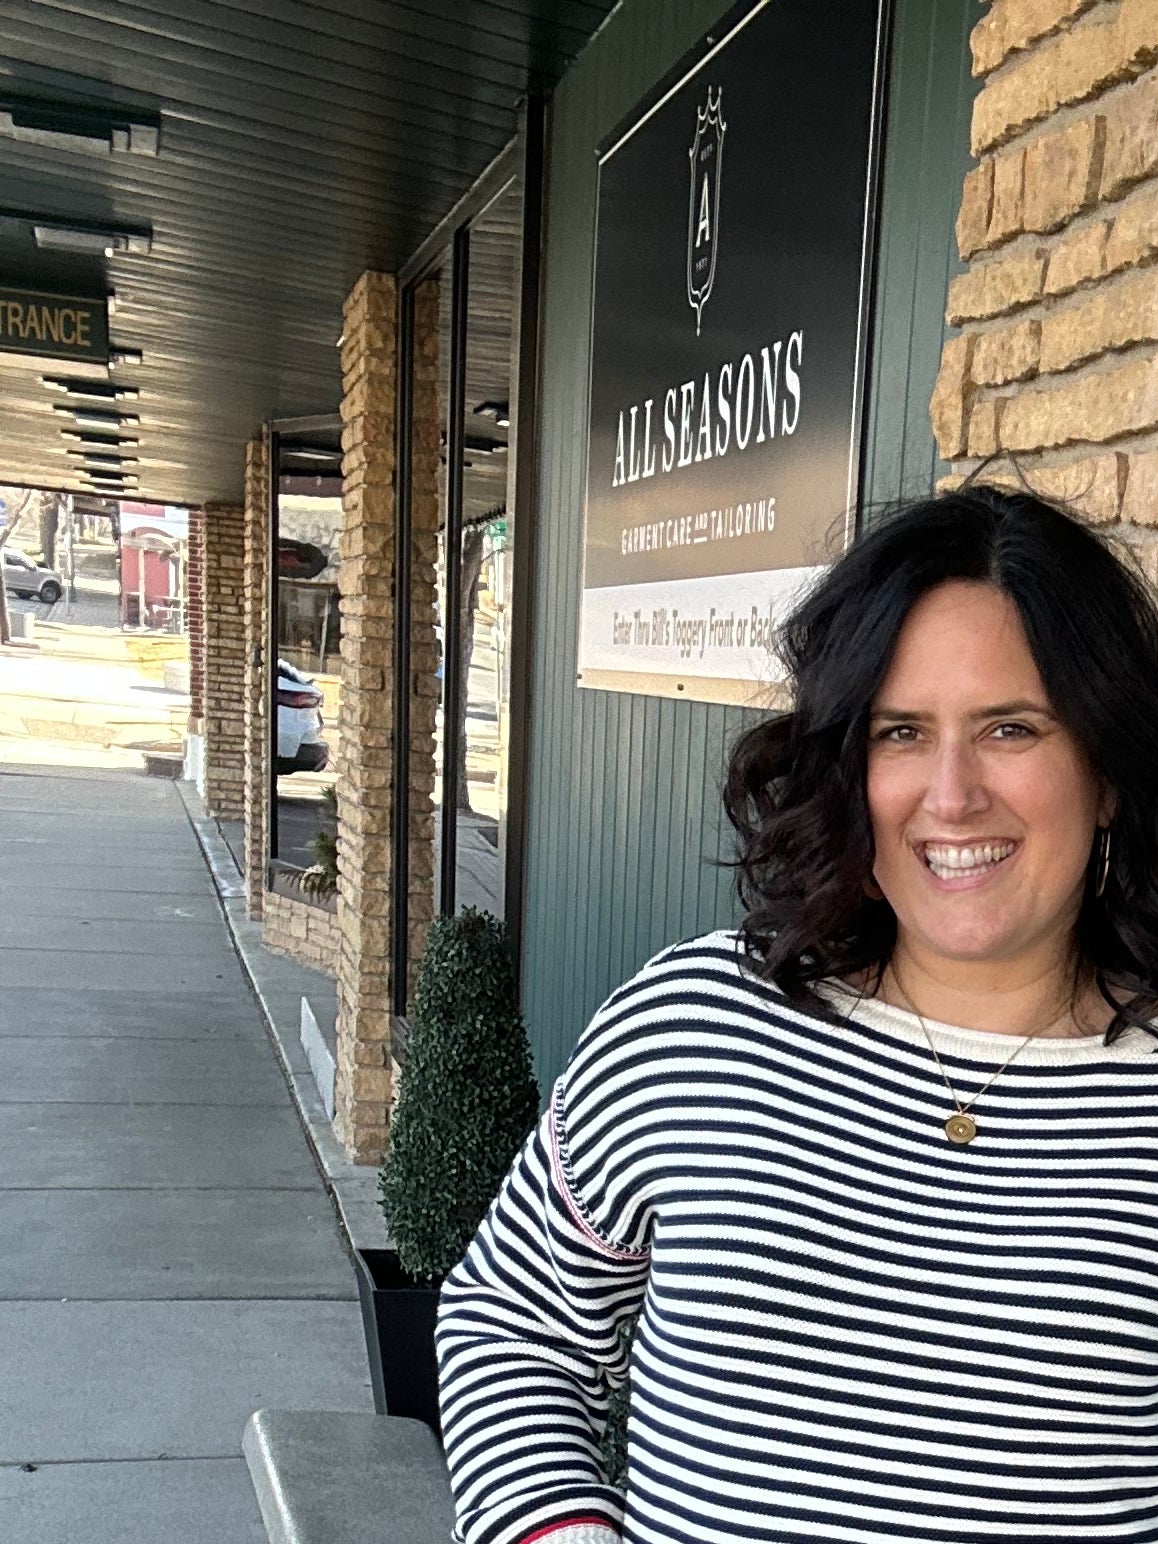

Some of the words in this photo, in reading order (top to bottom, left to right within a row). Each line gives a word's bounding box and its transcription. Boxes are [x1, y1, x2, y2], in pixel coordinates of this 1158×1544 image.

[696, 171, 710, 248] A
[612, 399, 656, 487] ALL
[662, 329, 803, 473] SEASONS
[621, 521, 664, 555] GARMENT
[666, 515, 692, 548] CARE
[695, 512, 708, 531] AND
[710, 497, 776, 540] TAILORING
[634, 608, 651, 646] Thru
[672, 609, 707, 659] Toggery
[708, 607, 735, 647] Front
[736, 617, 748, 647] or
